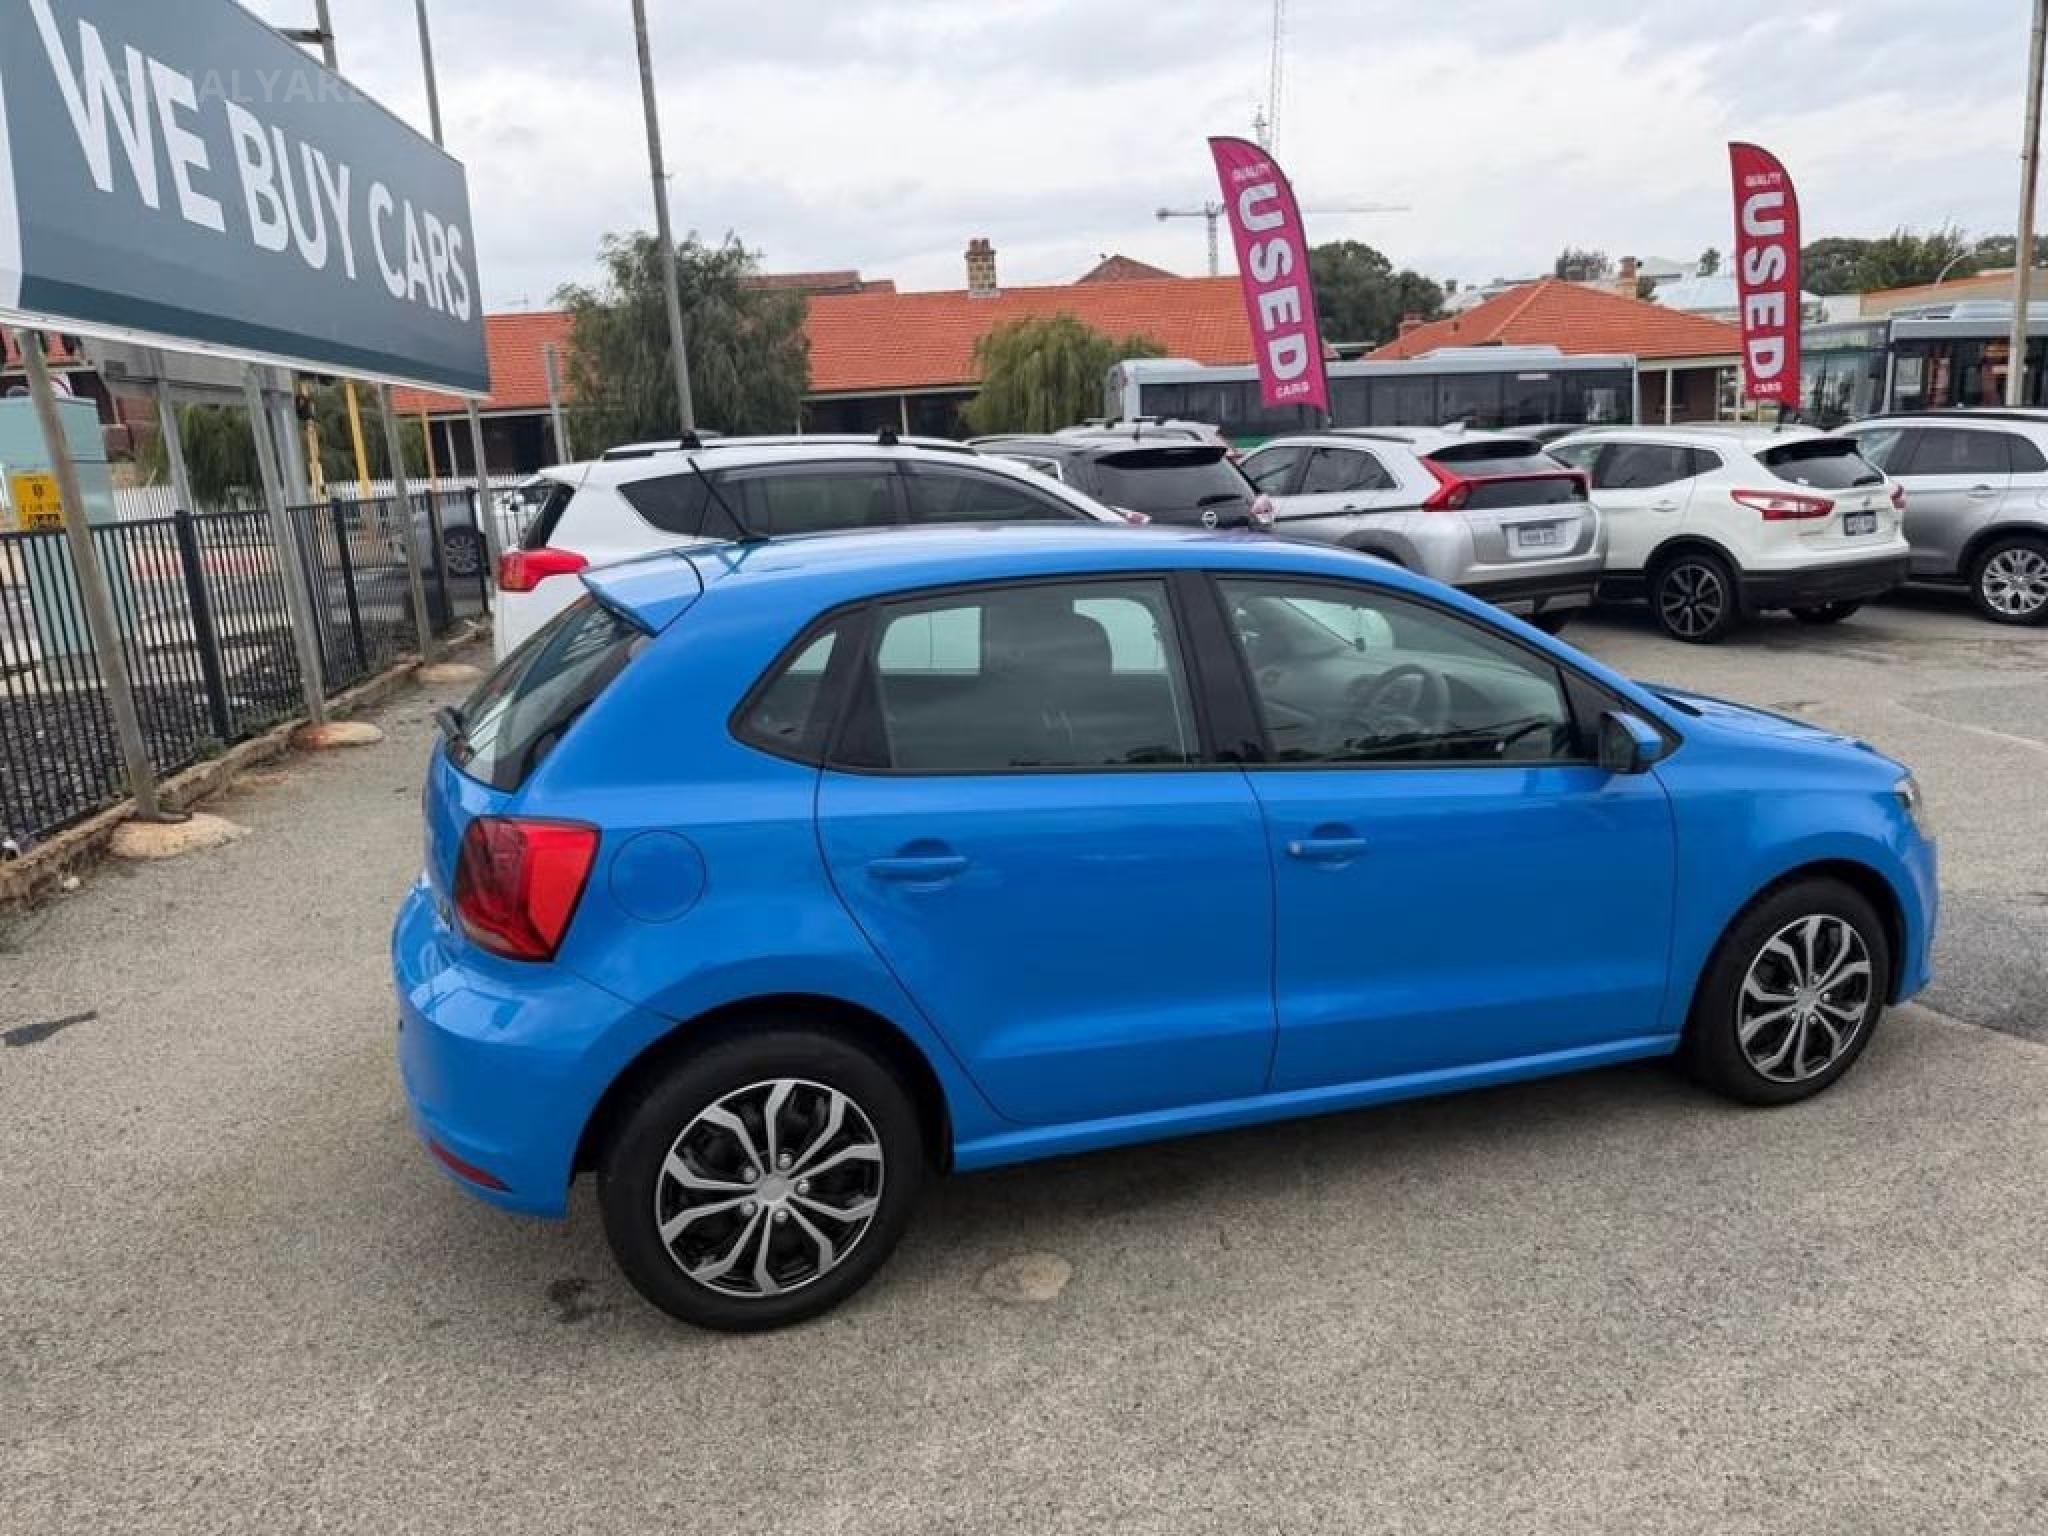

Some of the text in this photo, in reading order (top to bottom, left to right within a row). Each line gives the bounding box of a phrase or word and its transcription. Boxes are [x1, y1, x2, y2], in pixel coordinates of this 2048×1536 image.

[31, 0, 471, 322] WE BUY CARS
[1239, 182, 1309, 380] USED
[1742, 191, 1787, 380] USED
[1275, 381, 1310, 399] CARS
[1753, 381, 1783, 394] CARS
